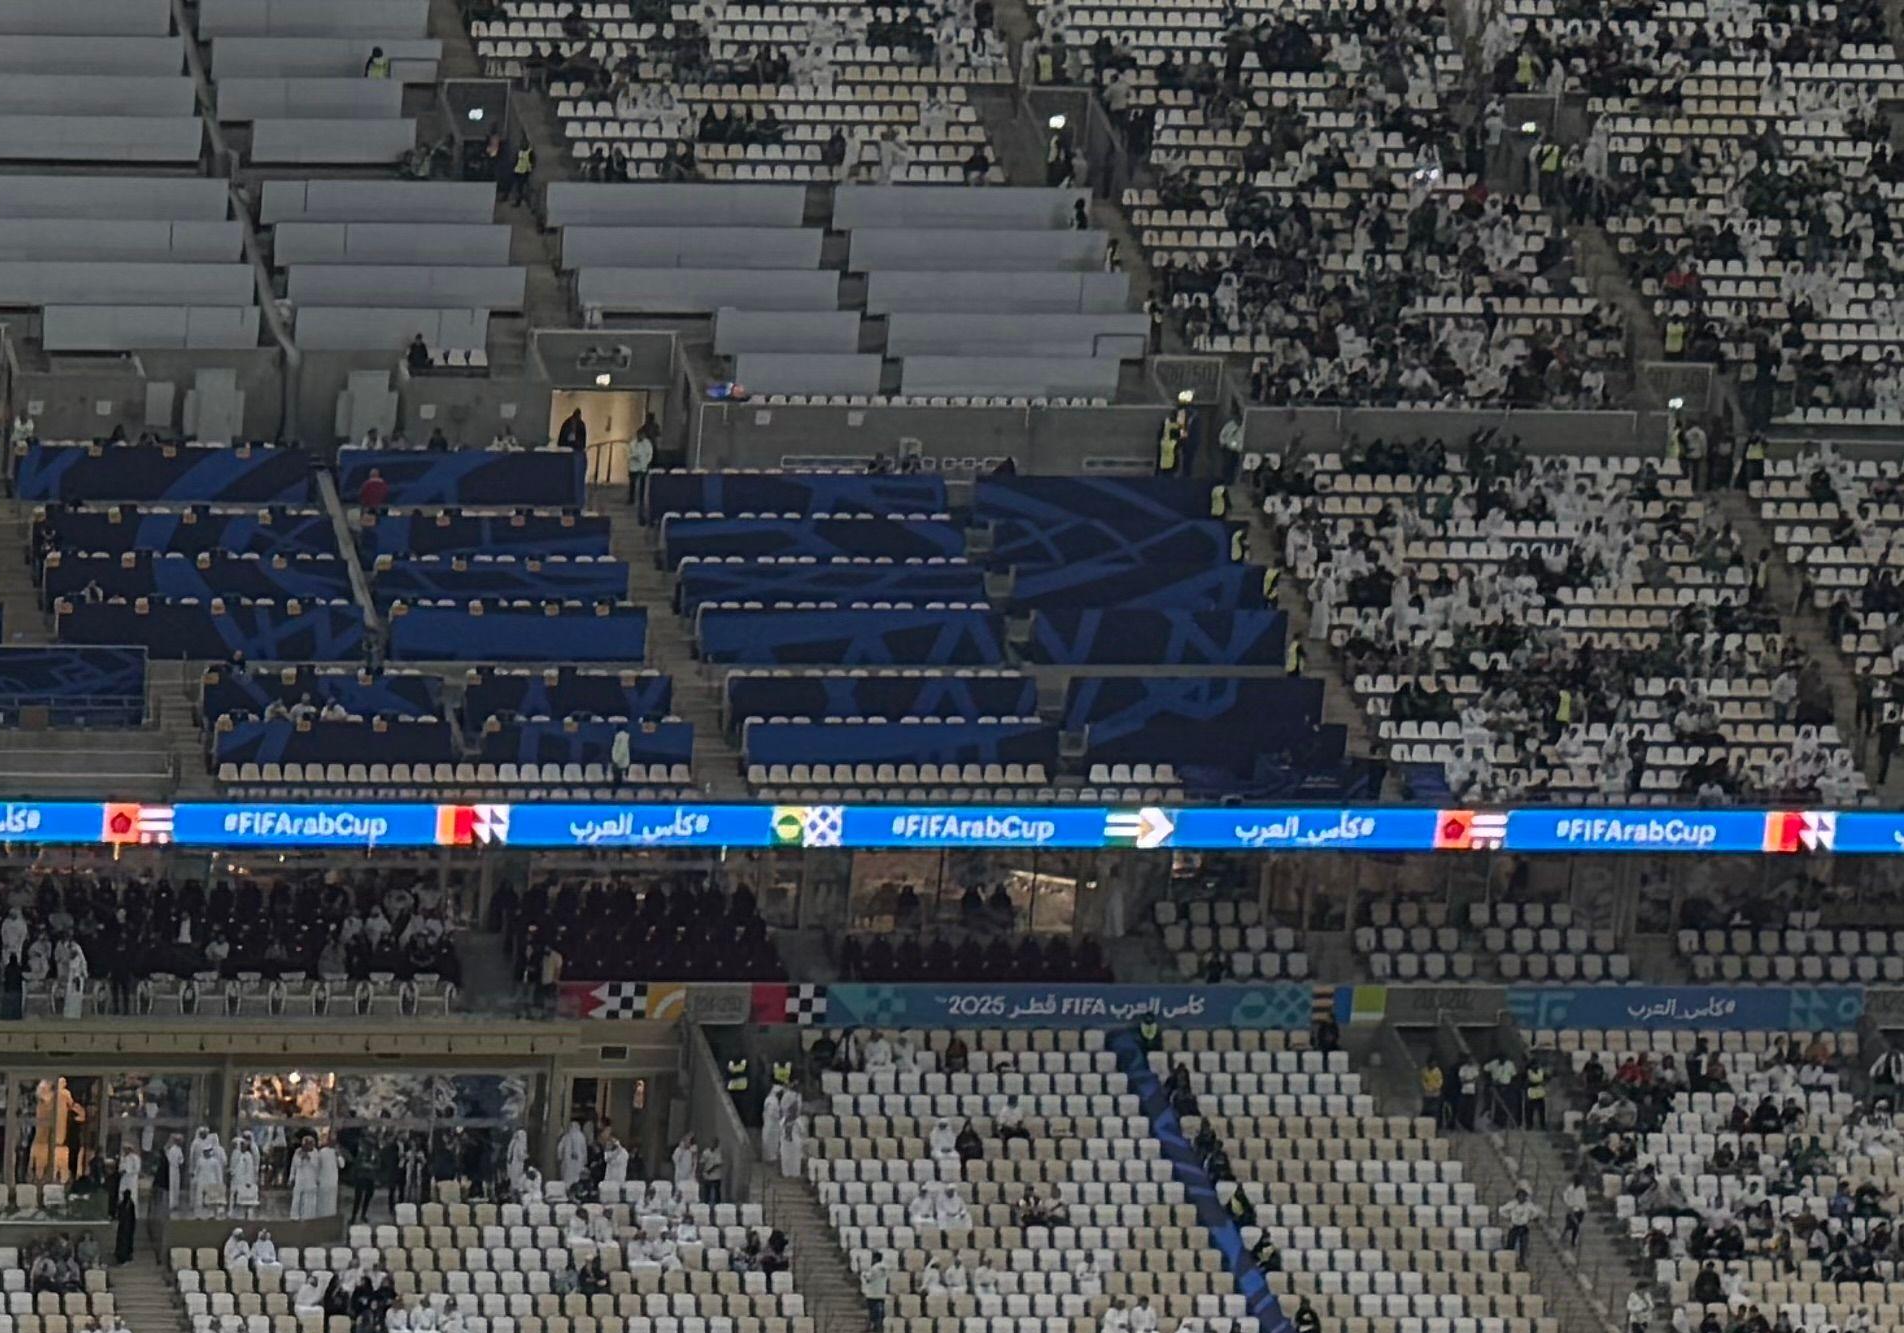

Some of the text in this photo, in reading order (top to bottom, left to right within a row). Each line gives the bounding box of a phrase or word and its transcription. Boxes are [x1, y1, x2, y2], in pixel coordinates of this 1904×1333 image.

[224, 811, 387, 842] #FIFArabCup
[892, 815, 1055, 846] #FIFArabCup
[1557, 819, 1717, 850] #FIFArabCup
[1008, 993, 1057, 1018] قطر
[1062, 997, 1106, 1015] FIFA
